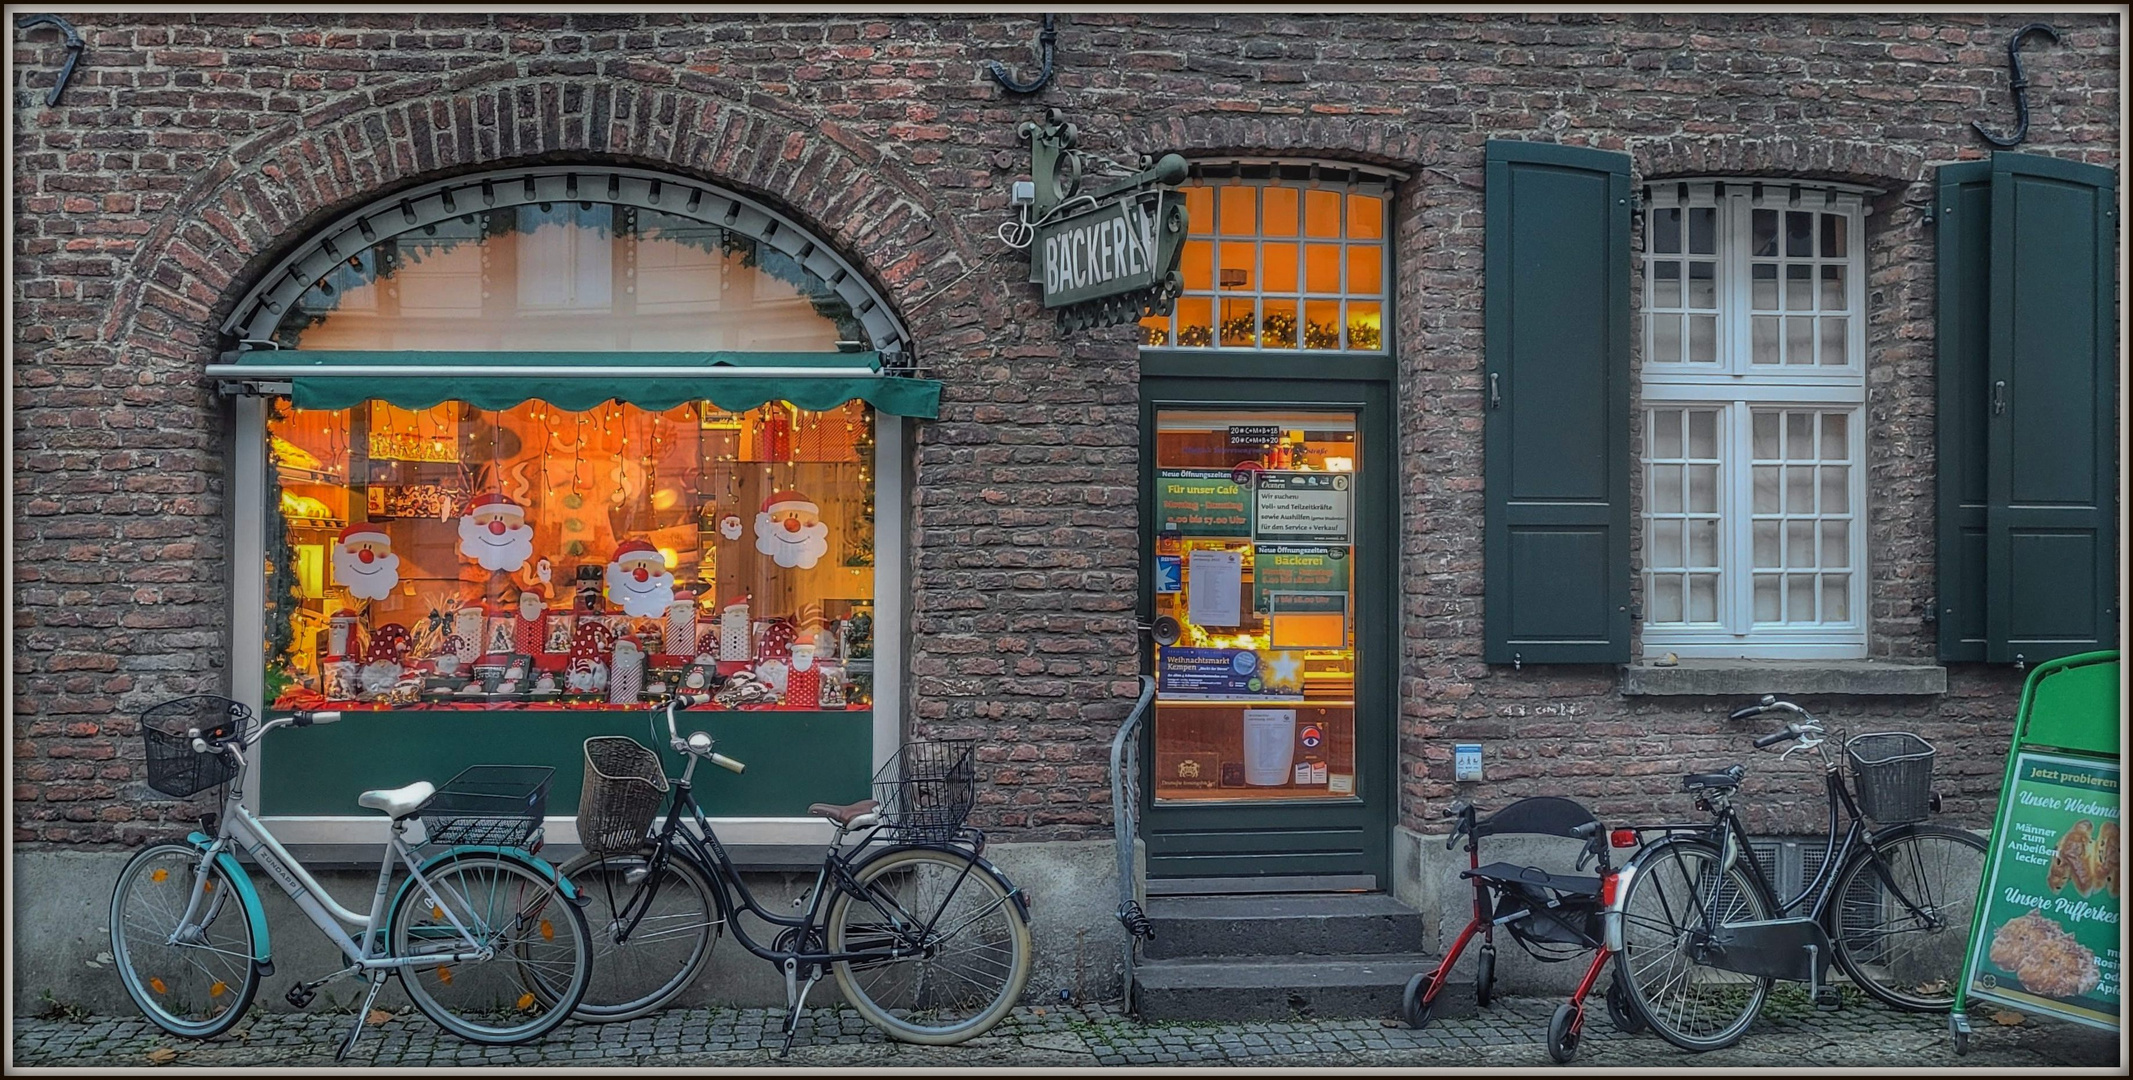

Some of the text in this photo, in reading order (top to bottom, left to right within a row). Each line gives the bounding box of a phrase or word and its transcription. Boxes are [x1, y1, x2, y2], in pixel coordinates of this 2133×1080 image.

[1161, 469, 1232, 480] Neue Öffnungszeiten
[1167, 484, 1239, 495] Für unser Café
[1276, 546, 1328, 555] Öffnungszeiten
[1274, 556, 1323, 566] Bäckerei
[1167, 656, 1230, 665] Weihnachtsmarkt
[1167, 663, 1197, 672] Kempen
[2030, 767, 2118, 788] Jetzt probieren
[2019, 790, 2061, 810] Unsere
[2015, 822, 2057, 838] Männer
[2021, 833, 2046, 844] zum
[2007, 840, 2060, 858] Anbeißen
[2015, 851, 2049, 866] lecker
[2004, 886, 2052, 910] Unsere
[2103, 972, 2120, 982] od
